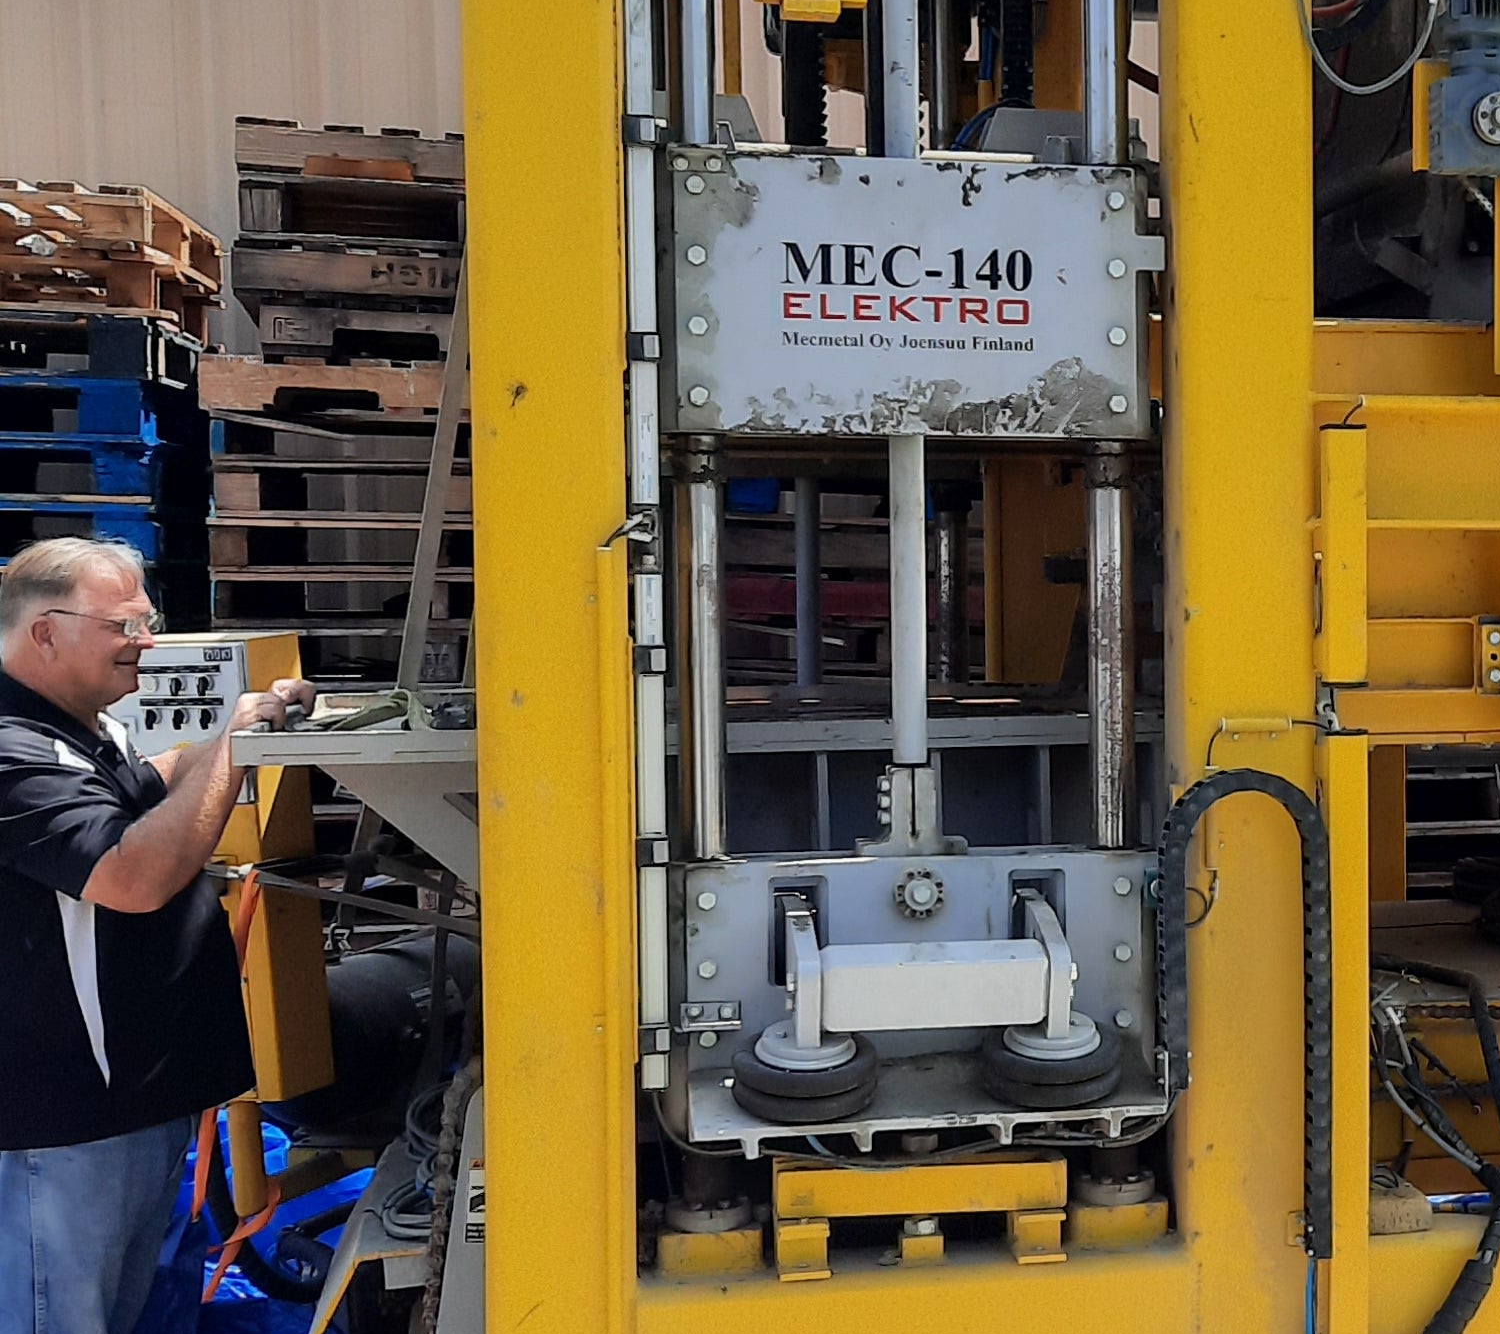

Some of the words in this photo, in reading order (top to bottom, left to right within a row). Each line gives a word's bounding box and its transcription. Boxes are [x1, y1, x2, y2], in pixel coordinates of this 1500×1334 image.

[781, 241, 1033, 291] MEC-140
[783, 292, 1031, 325] ELEKTRO
[781, 331, 864, 347] Mecmetal
[870, 333, 894, 351] Oy
[899, 334, 966, 349] Joensuu
[972, 336, 1034, 352] Finland
